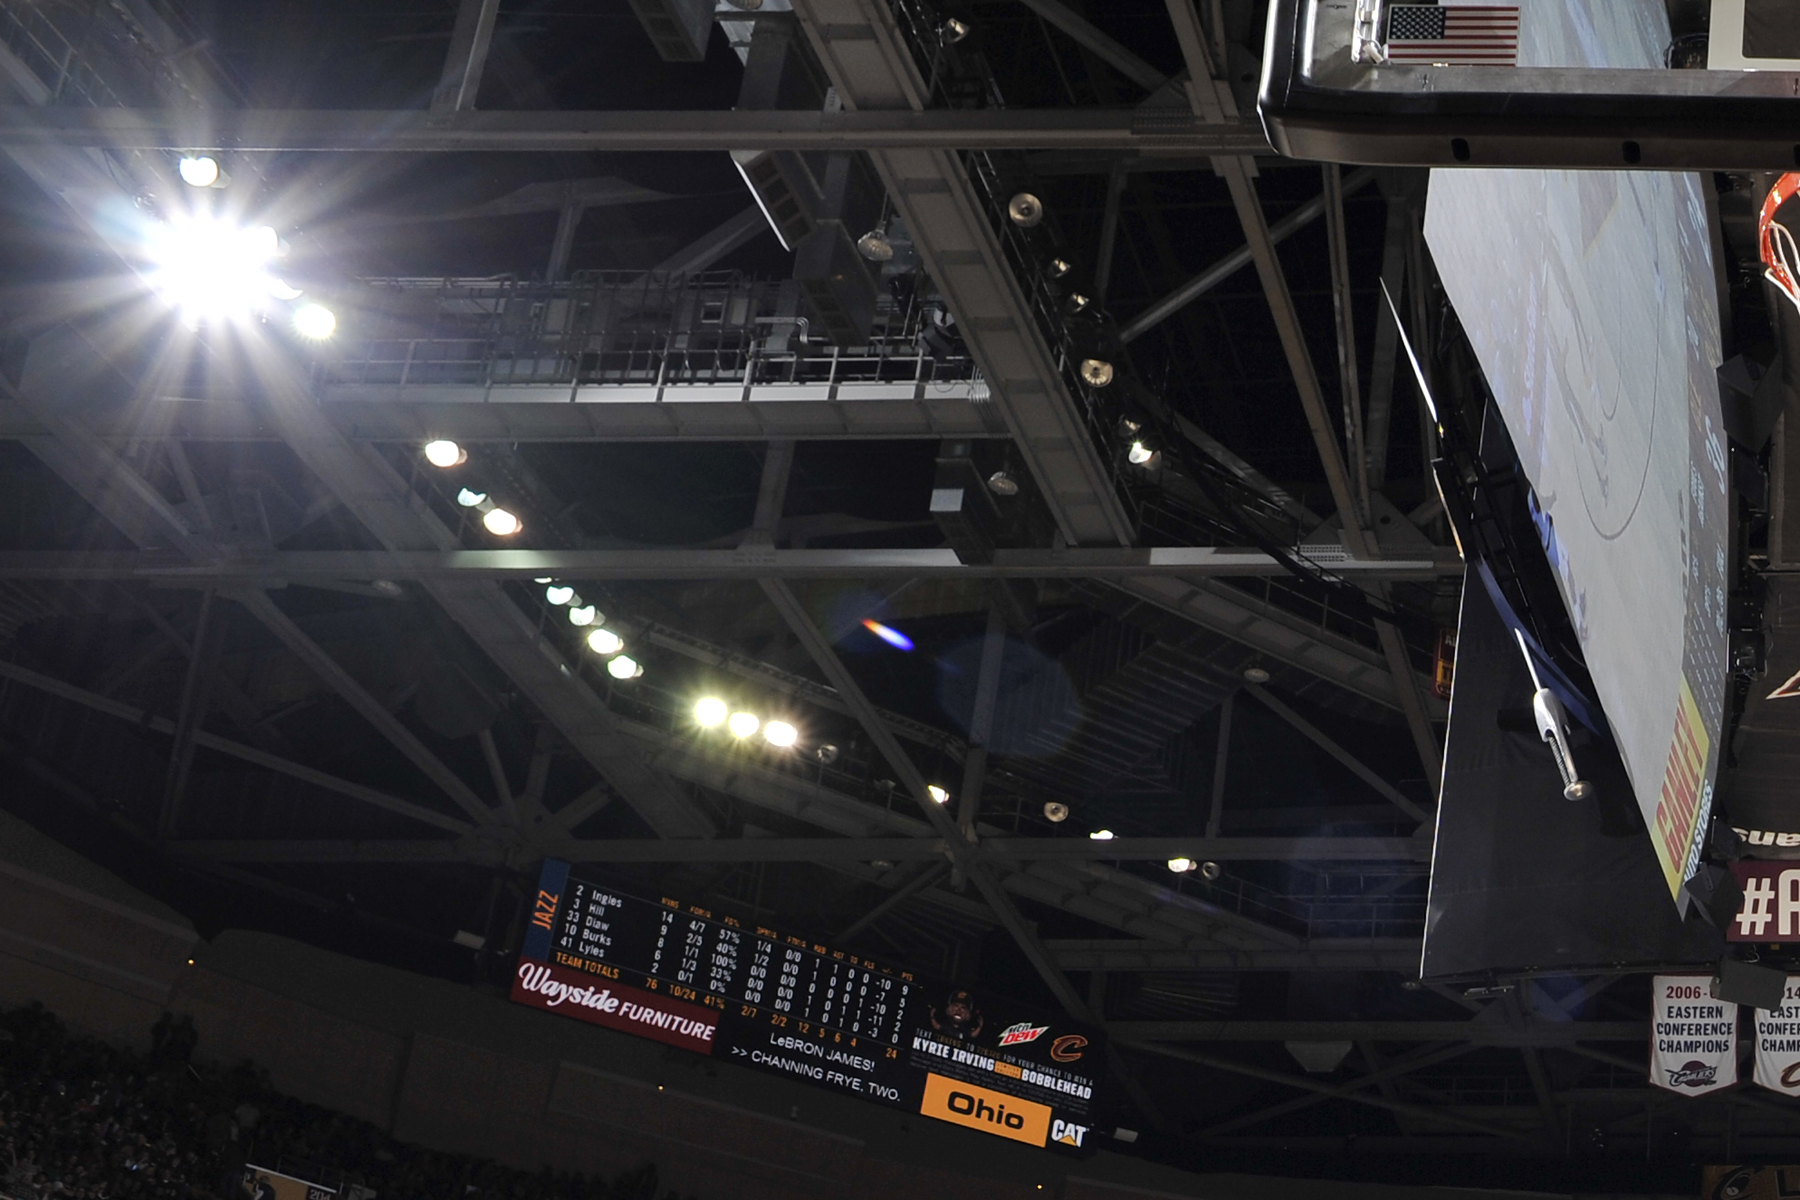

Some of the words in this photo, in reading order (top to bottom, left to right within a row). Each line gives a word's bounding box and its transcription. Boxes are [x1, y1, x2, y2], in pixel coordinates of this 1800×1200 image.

[532, 890, 559, 930] JAZZ
[588, 903, 605, 916] Hill
[716, 942, 738, 957] 40%
[592, 890, 622, 908] Ingles
[719, 928, 740, 944] 57%
[578, 941, 605, 958] Lyles
[582, 929, 612, 946] Burks
[710, 966, 732, 982] 33%
[585, 916, 610, 932] Diaw
[711, 953, 737, 970] 100%
[556, 951, 582, 969] TEAM
[583, 959, 620, 980] TOTALS
[669, 983, 697, 1001] 10/24
[518, 962, 620, 1013] Wayside
[618, 1001, 716, 1041] FURNITURE
[1667, 1006, 1723, 1019] EASTERN
[1657, 1022, 1733, 1036] CONFERENCE
[1660, 1039, 1729, 1053] CHAMPIONS
[751, 1049, 824, 1081] CHANNING
[769, 1031, 825, 1058] LeBRON
[826, 1048, 876, 1073] JAMES!
[912, 1037, 951, 1060] KYRIE
[951, 1046, 996, 1072] IRVING
[1021, 1068, 1093, 1100] BOBBLEHEAD
[947, 1091, 1024, 1130] Ohio
[1051, 1119, 1087, 1148] CAT
